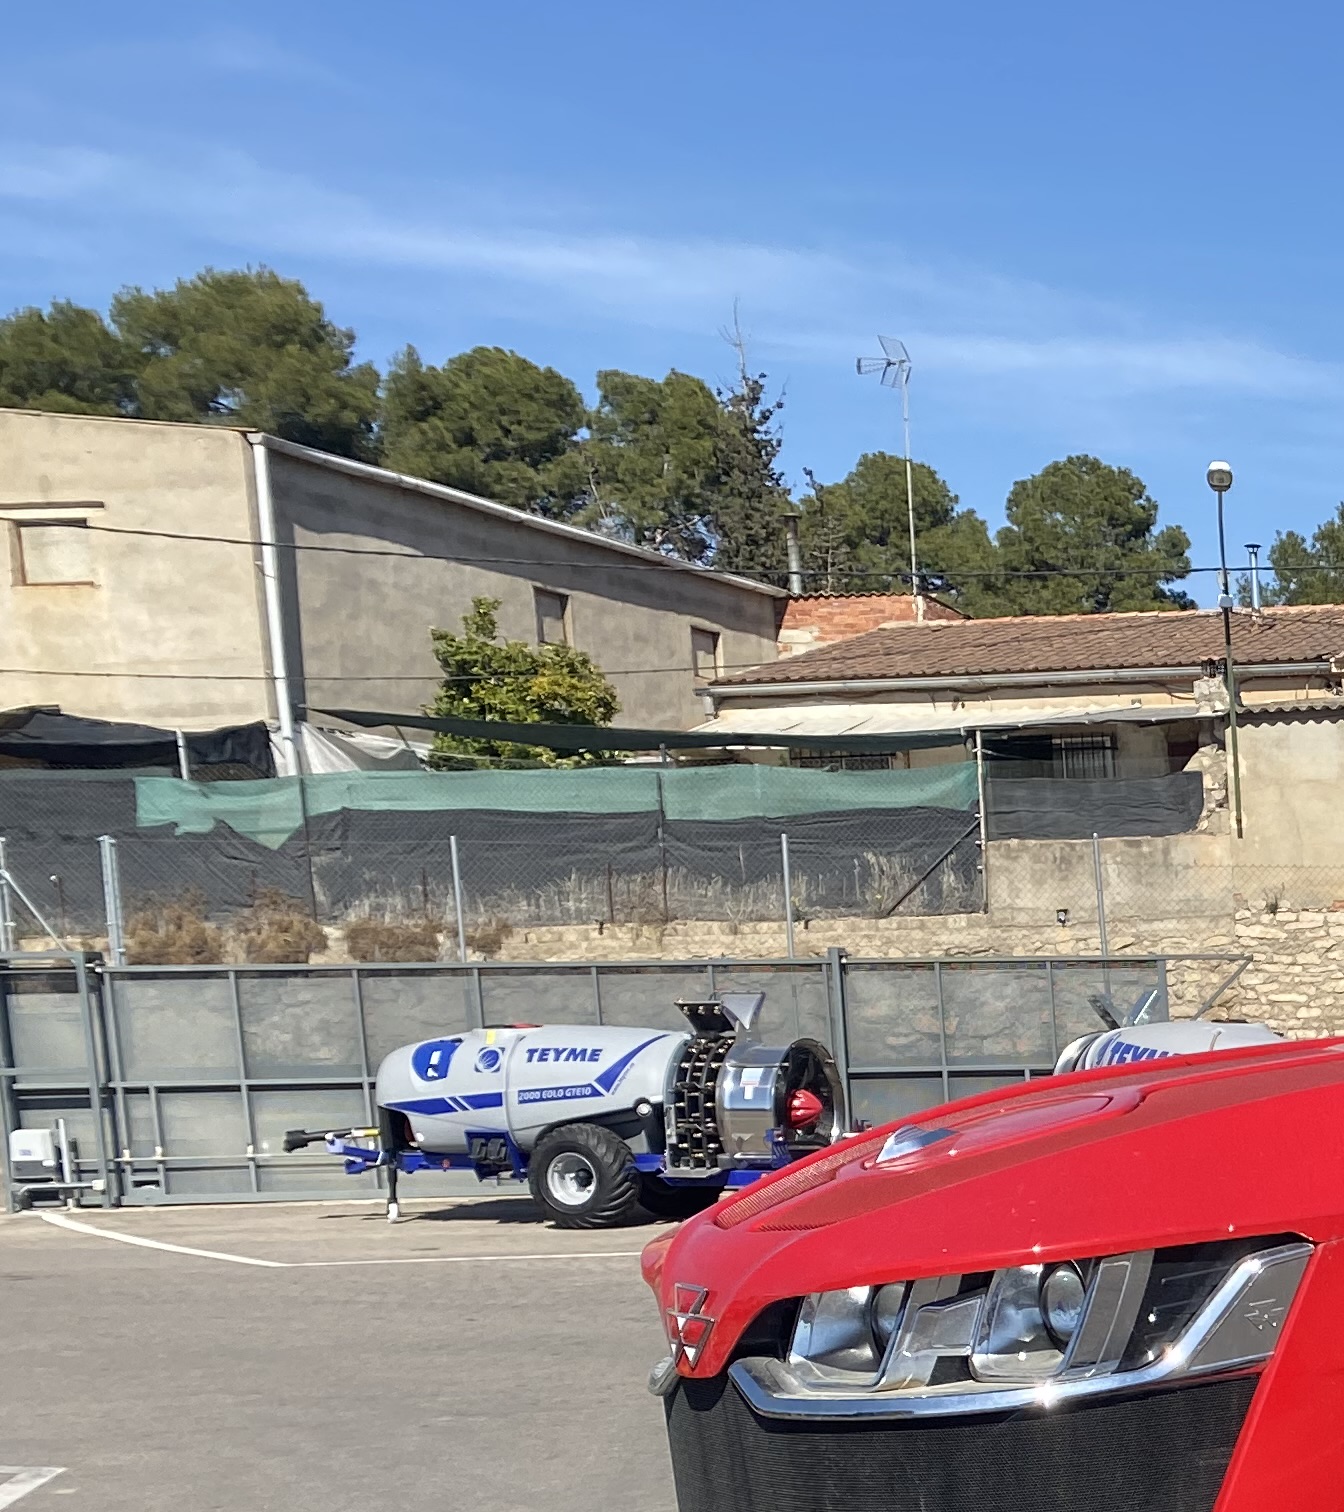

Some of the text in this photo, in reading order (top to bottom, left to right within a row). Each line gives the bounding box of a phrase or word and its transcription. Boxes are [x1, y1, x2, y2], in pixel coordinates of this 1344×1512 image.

[525, 1047, 603, 1063] TEYME
[1107, 1041, 1184, 1066] TEY
[518, 1091, 541, 1101] 2000
[542, 1088, 564, 1099] EOLO
